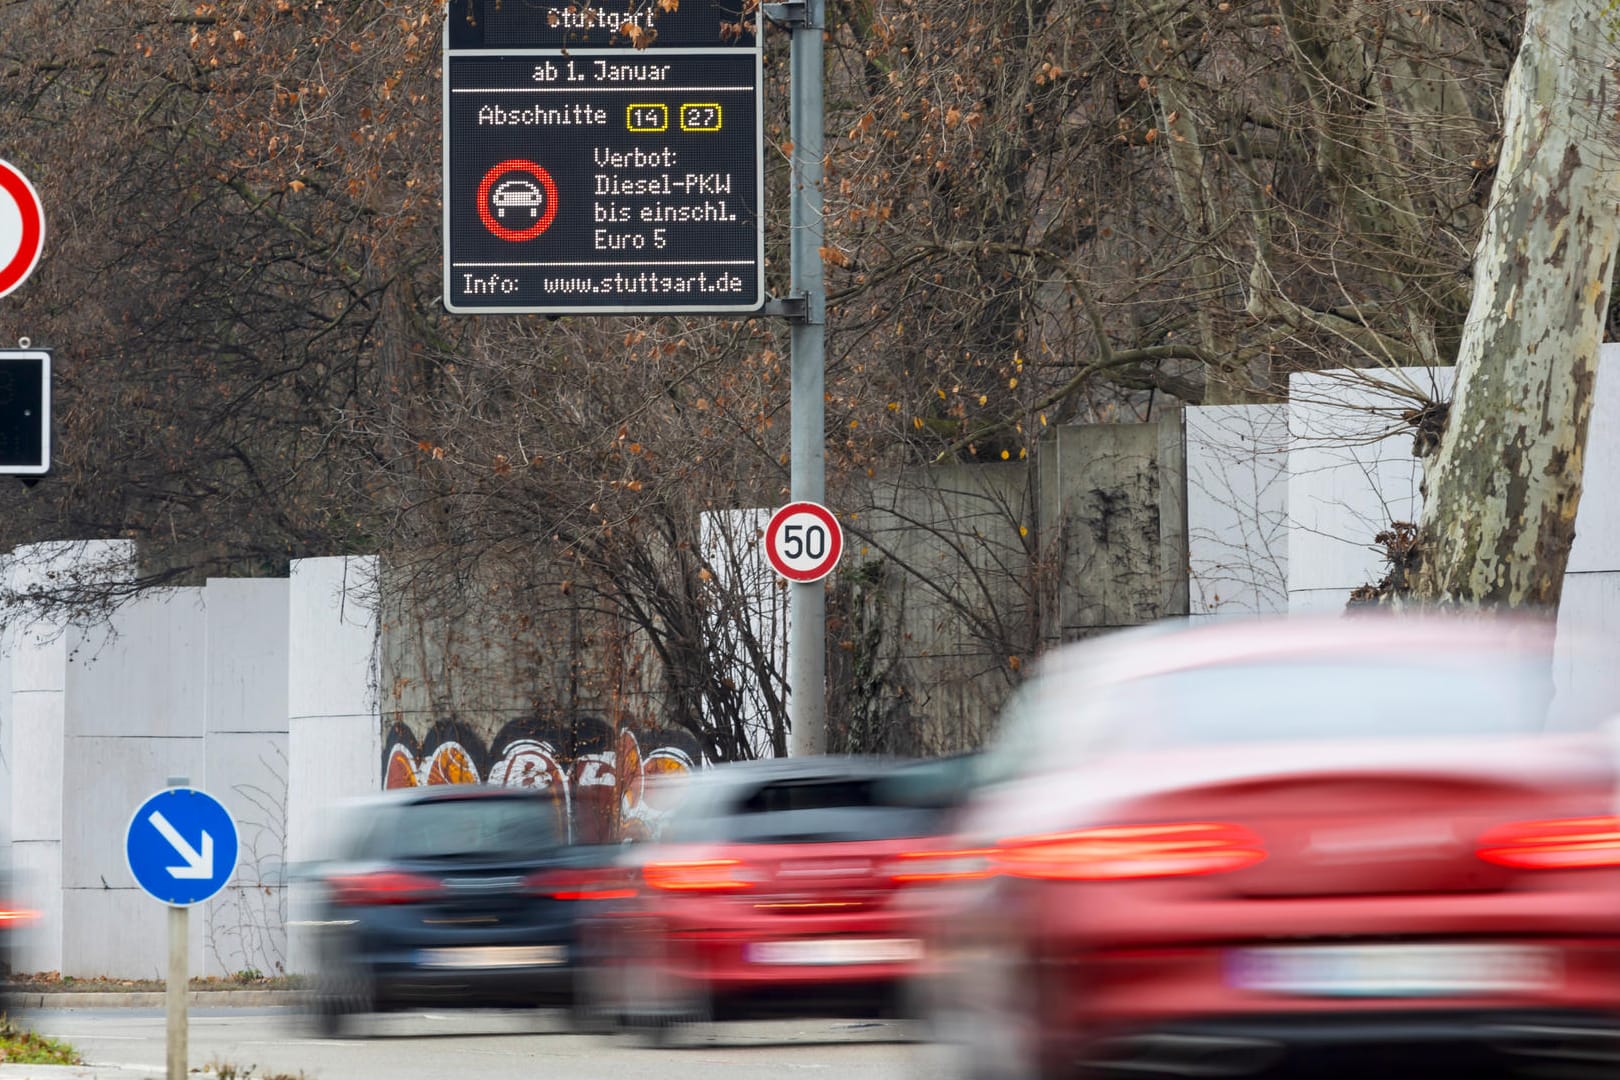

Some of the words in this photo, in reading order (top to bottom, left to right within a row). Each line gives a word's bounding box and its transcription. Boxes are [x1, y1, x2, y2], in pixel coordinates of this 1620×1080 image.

[532, 61, 558, 81] ab
[567, 61, 585, 81] 1.
[593, 60, 671, 81] Januar
[478, 104, 607, 125] Abschnitte
[634, 109, 658, 126] 14
[687, 109, 715, 126] 27
[594, 147, 677, 168] Verbot:
[594, 173, 731, 195] Diesel-PKW
[594, 202, 631, 222] bis
[640, 201, 737, 222] einschl.
[594, 228, 645, 250] Euro
[653, 228, 667, 249] 5
[463, 273, 519, 294] Info:
[543, 272, 743, 293] www.stuttgart.de
[784, 525, 825, 560] 50
